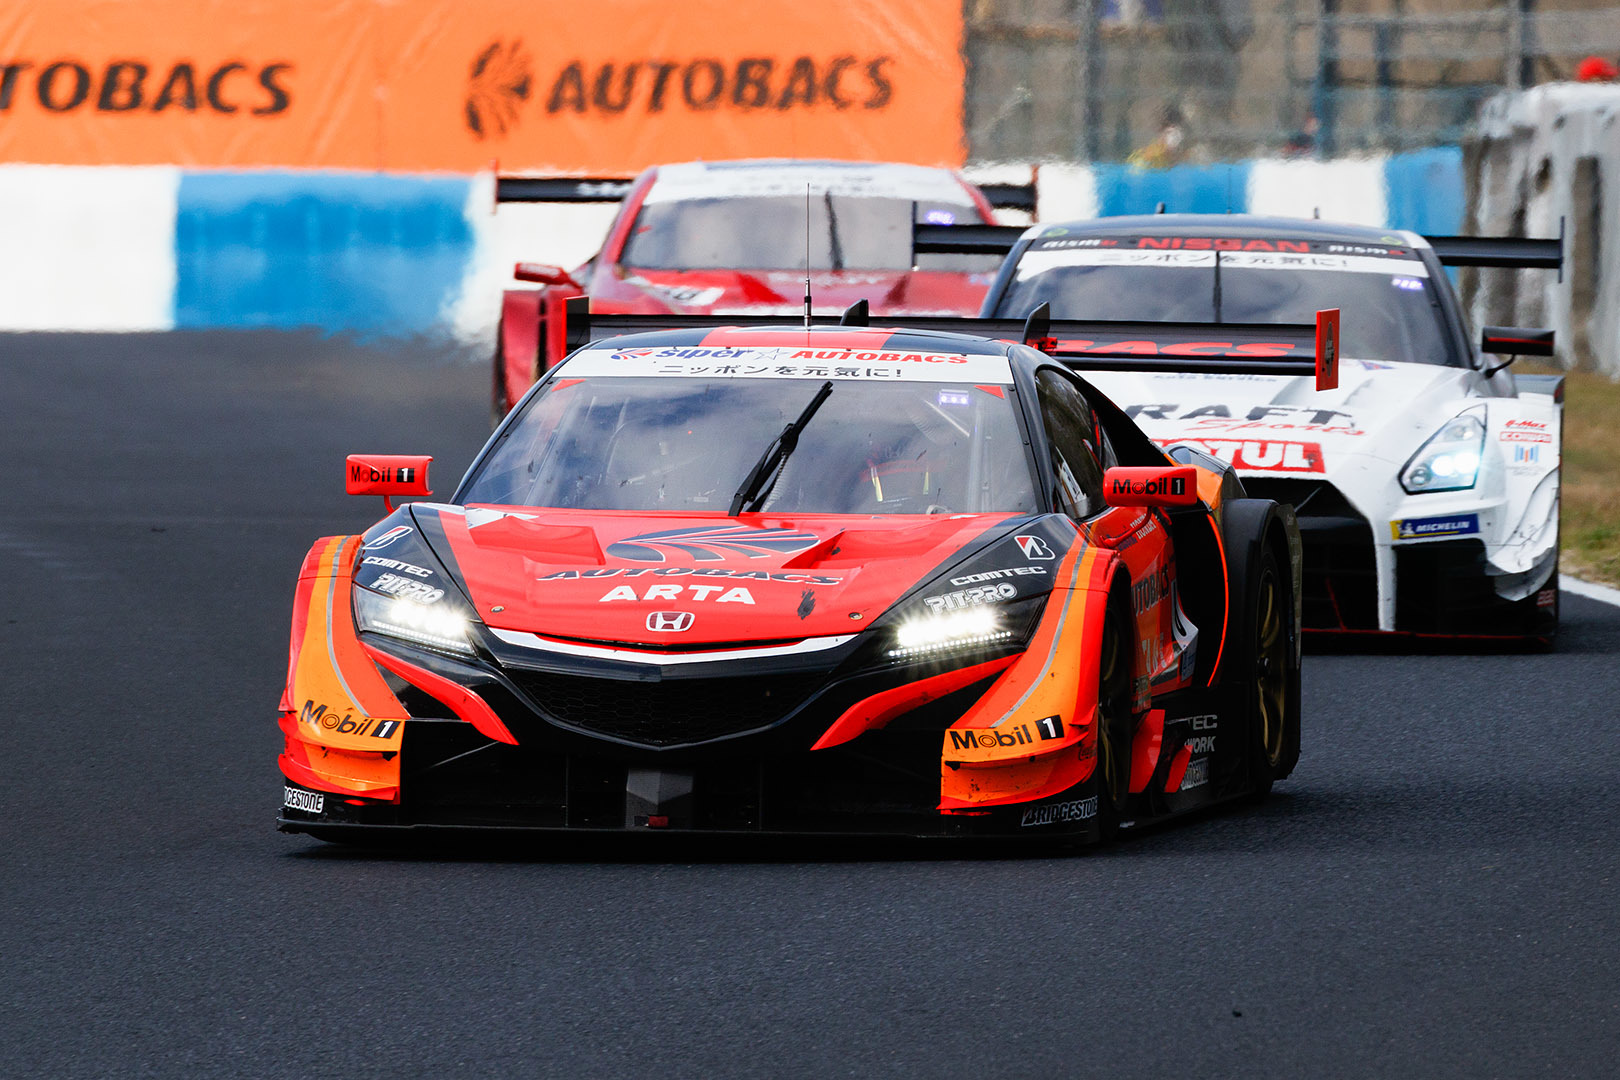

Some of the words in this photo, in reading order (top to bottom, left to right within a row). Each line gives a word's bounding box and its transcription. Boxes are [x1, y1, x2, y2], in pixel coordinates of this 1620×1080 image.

[0, 60, 293, 115] TOBACS
[546, 54, 895, 115] AUTOBACS
[1137, 237, 1310, 253] NISSAN
[789, 350, 969, 365] AUTOBACS
[1000, 338, 1295, 358] BACS
[351, 465, 391, 482] Mobil
[1113, 478, 1168, 496] Mobil
[1416, 521, 1470, 532] MICHELIN
[362, 556, 434, 578] COMTEC
[536, 568, 843, 585] AUTOBACS
[950, 566, 1047, 586] COMTEC
[599, 585, 756, 605] ARTA
[300, 699, 374, 736] Mobil
[950, 724, 1033, 750] Mobil
